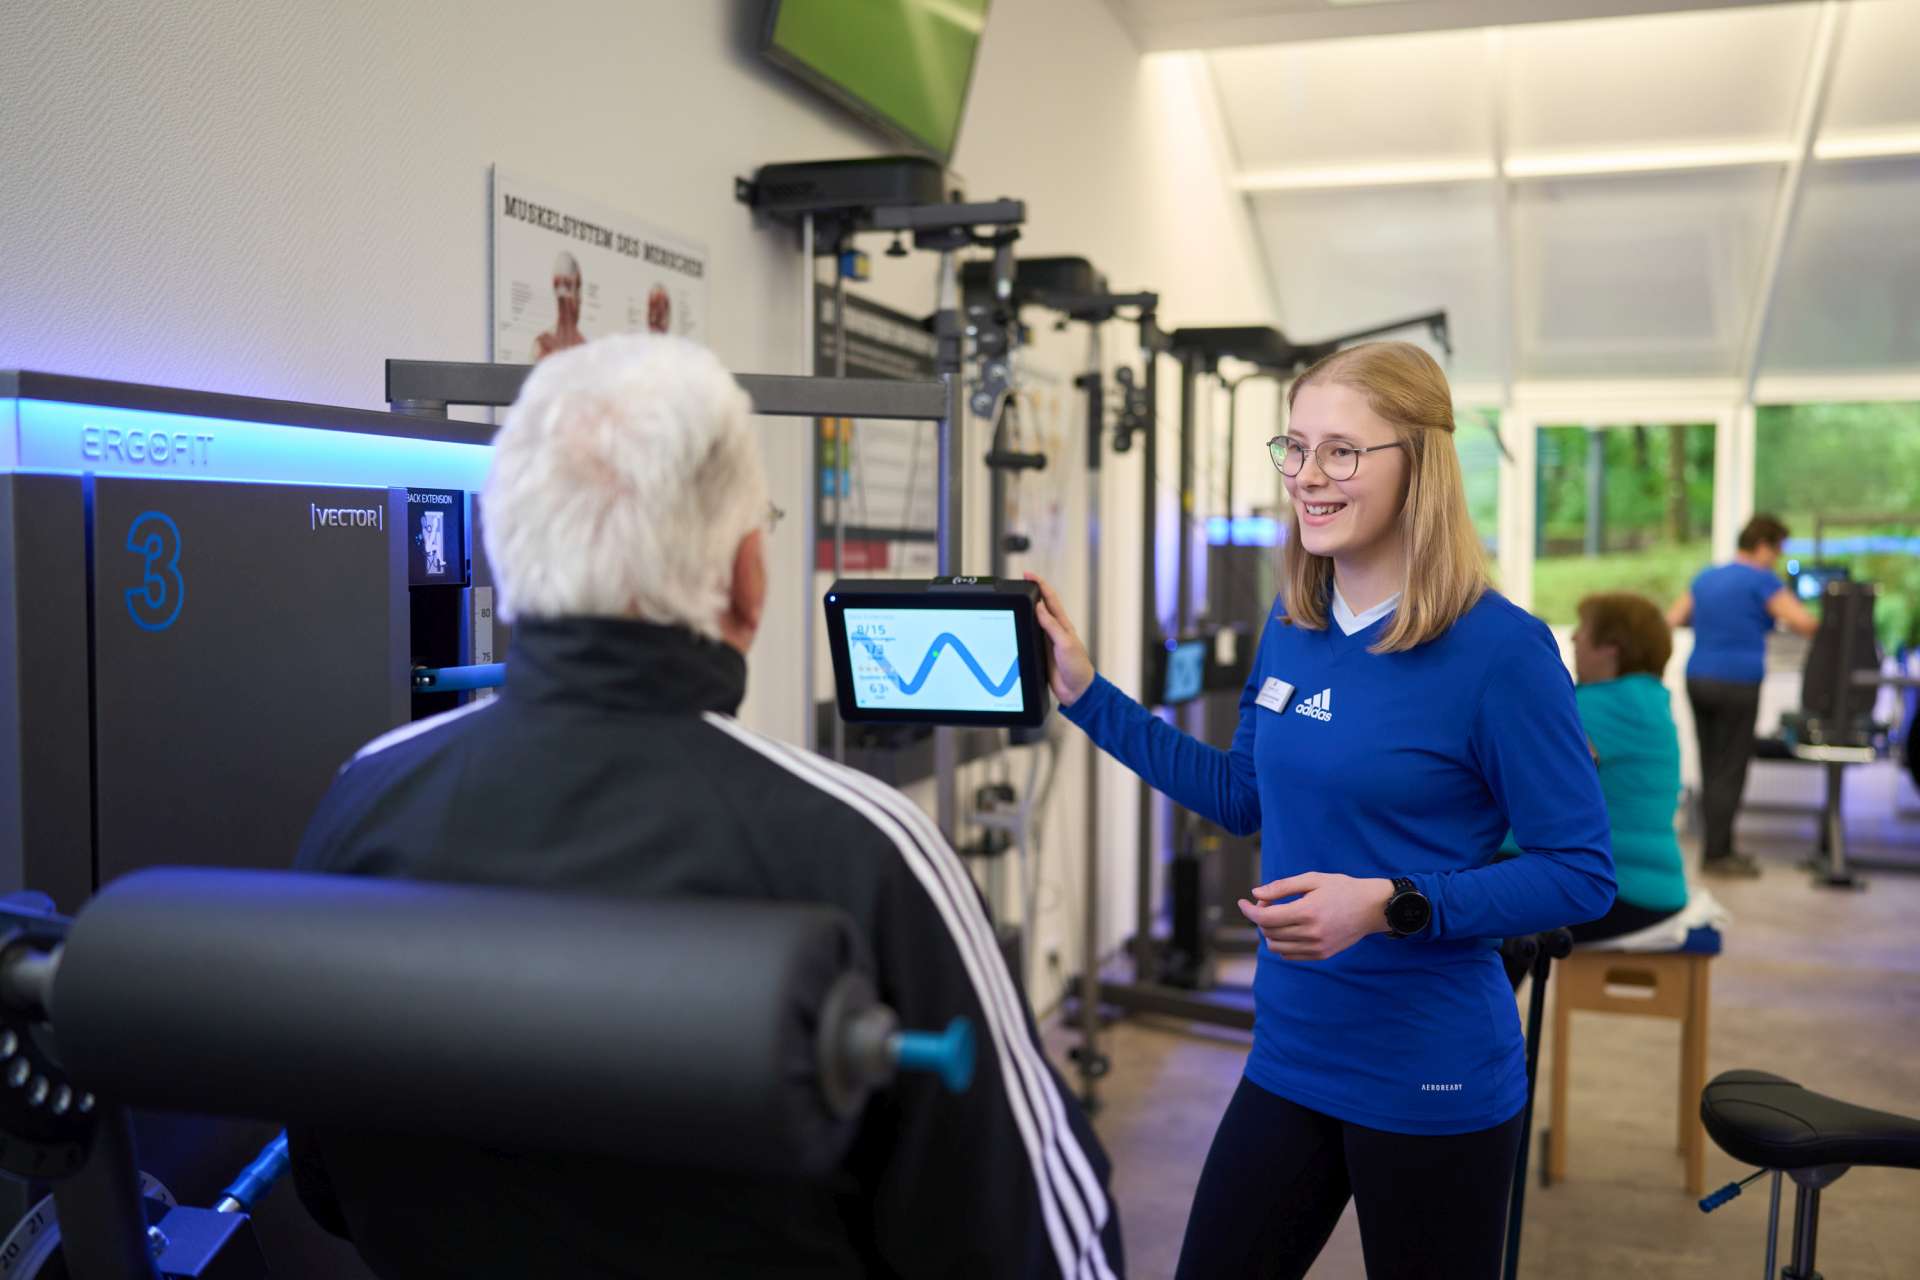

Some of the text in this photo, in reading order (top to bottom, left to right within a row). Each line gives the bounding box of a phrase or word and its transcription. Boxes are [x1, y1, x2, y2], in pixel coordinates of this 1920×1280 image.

[504, 194, 613, 250] MUSKELSYSTEM
[616, 233, 641, 258] DES
[81, 425, 214, 466] ERGOFIT
[421, 494, 453, 505] EXTENSION
[124, 510, 185, 632] 3
[481, 608, 491, 618] 80
[1295, 704, 1332, 721] adidas
[27, 1211, 44, 1234] 21
